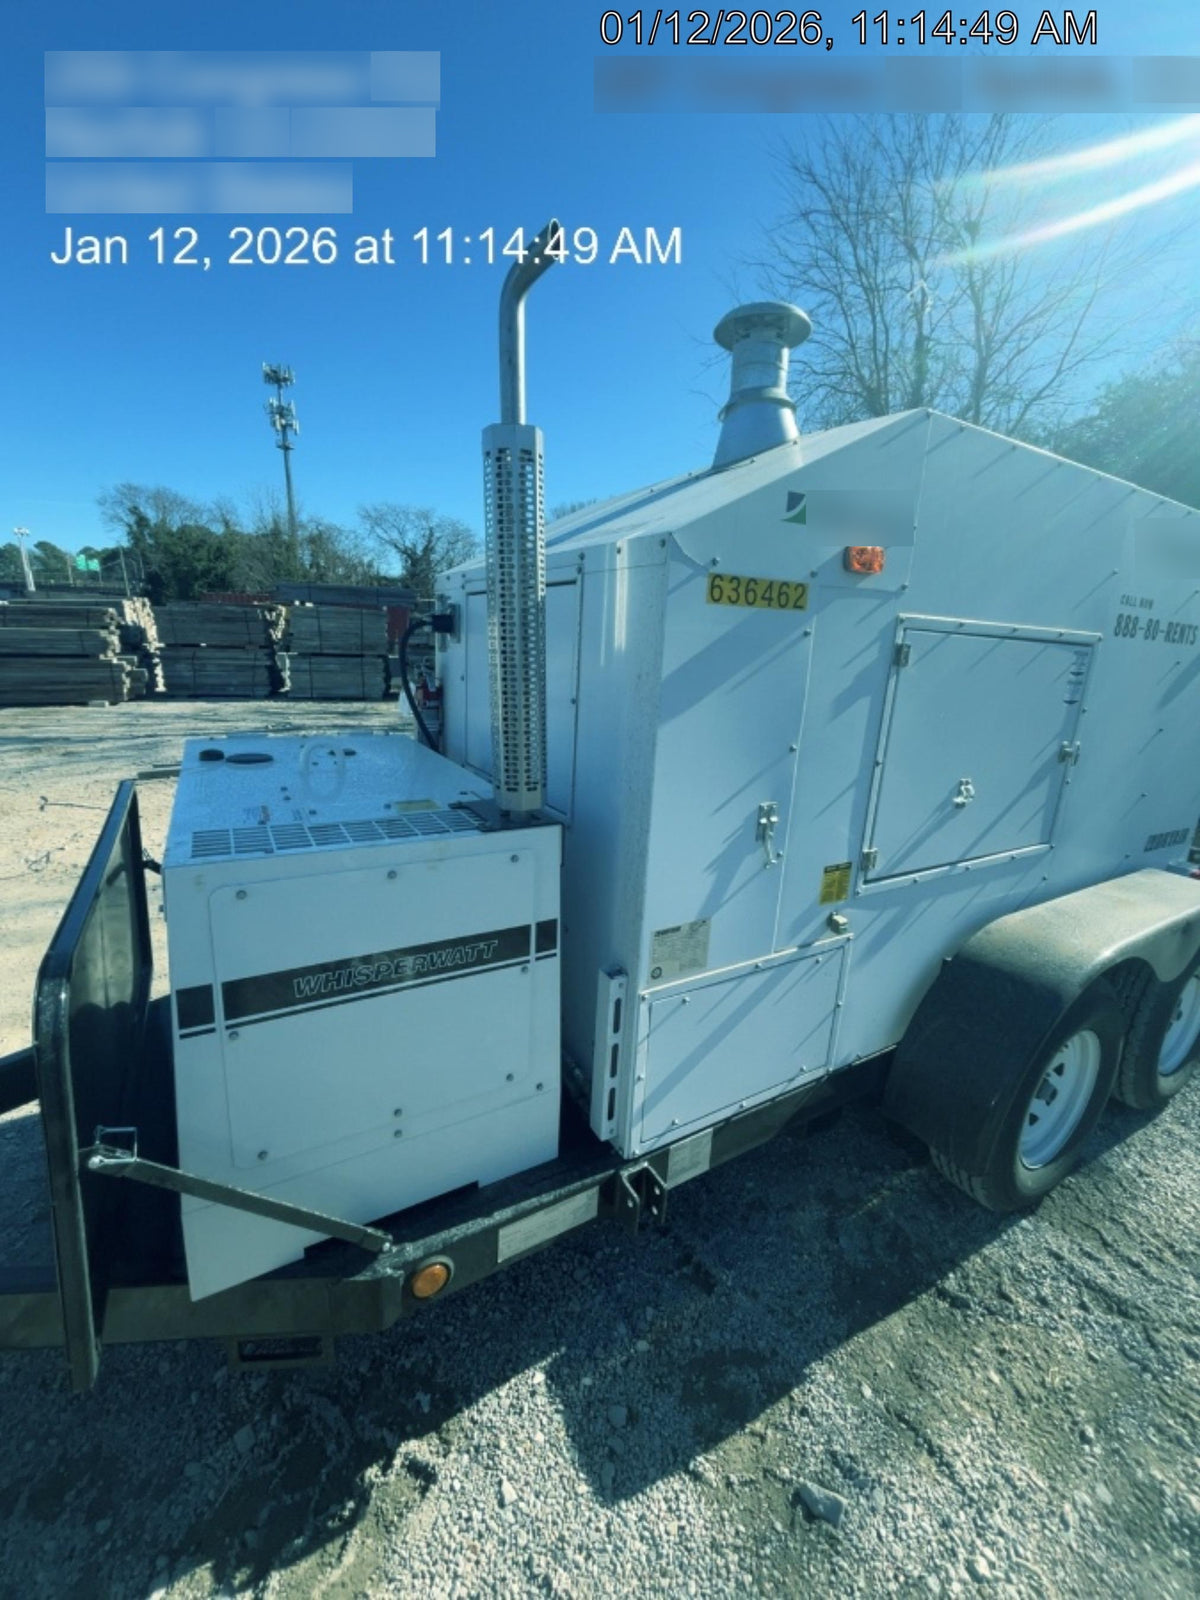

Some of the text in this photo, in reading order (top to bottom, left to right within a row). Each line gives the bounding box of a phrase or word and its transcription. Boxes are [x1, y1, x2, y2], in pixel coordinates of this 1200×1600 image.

[710, 574, 806, 609] 636462
[1120, 594, 1137, 607] CALL
[1114, 613, 1198, 646] 888-80-RENTS
[292, 939, 498, 998] WHISPERWATT
